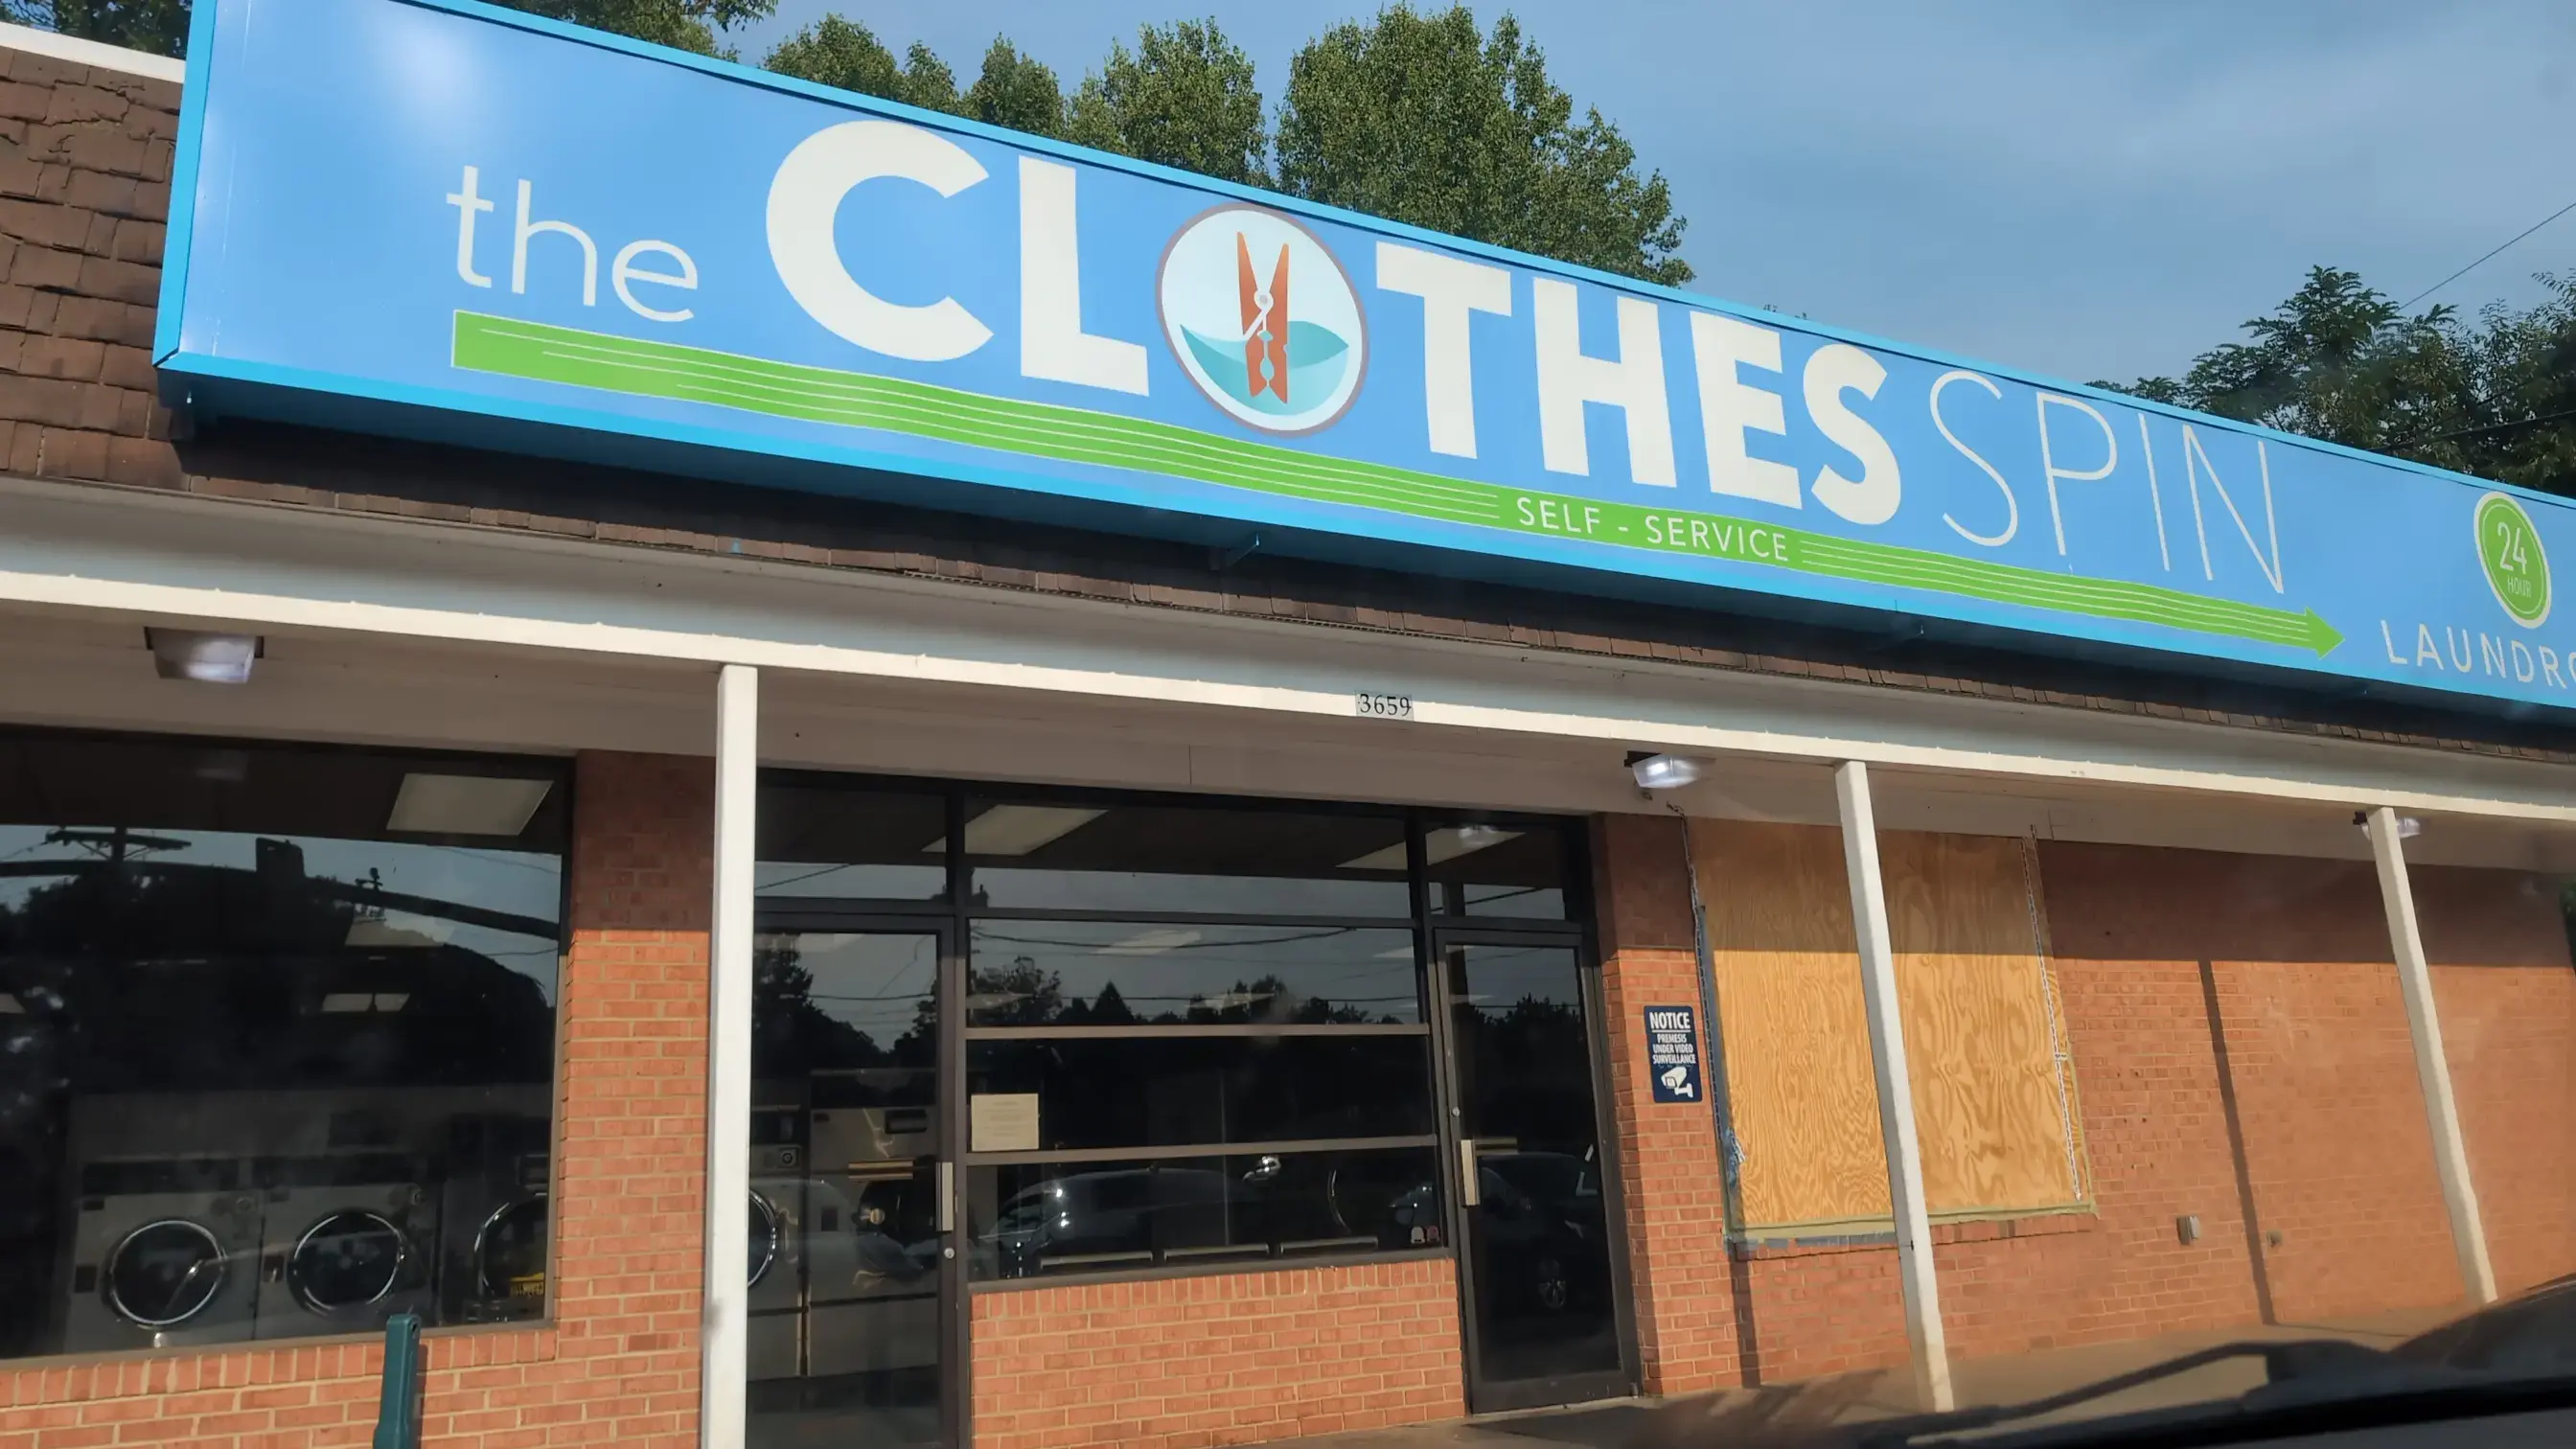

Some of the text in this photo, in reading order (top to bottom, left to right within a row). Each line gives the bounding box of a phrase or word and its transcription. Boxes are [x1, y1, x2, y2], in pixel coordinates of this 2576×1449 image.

[446, 166, 699, 323] the
[1929, 371, 2284, 594] SPIN
[1516, 496, 1600, 534] SELF
[1644, 515, 1790, 562] SERVICE
[2497, 521, 2528, 575] 24
[2507, 577, 2532, 599] HOUR
[1360, 693, 1411, 717] 3659
[1649, 1012, 1690, 1029] NOTICE
[1652, 1044, 1693, 1053] UNDER VIDEO
[1652, 1054, 1696, 1065] SURVEILLANCE
